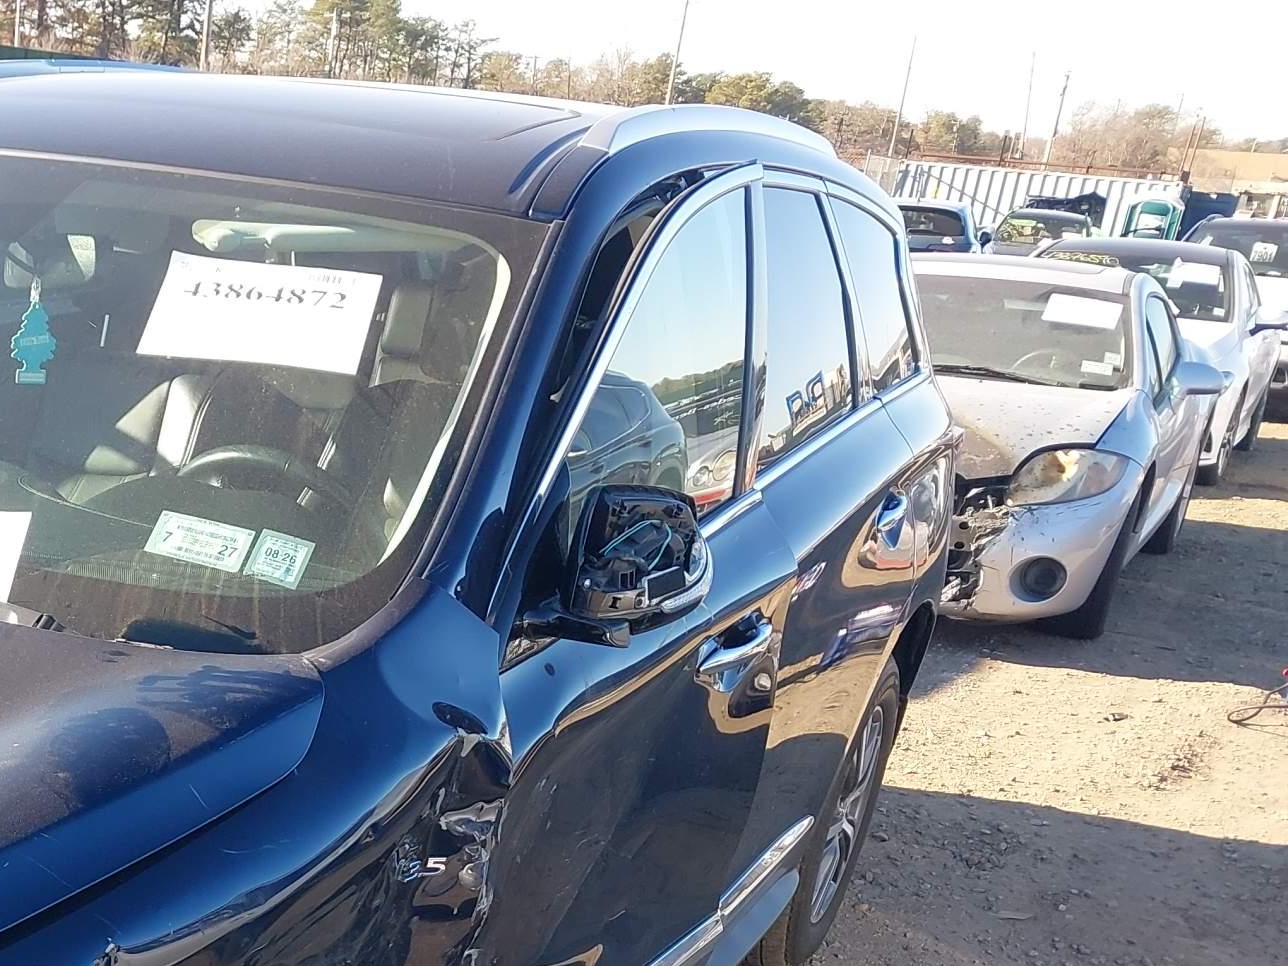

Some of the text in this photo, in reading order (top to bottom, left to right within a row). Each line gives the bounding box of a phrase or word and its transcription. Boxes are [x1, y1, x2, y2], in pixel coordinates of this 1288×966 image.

[183, 280, 347, 310] 43864872
[162, 531, 174, 543] 7
[217, 544, 239, 558] 27
